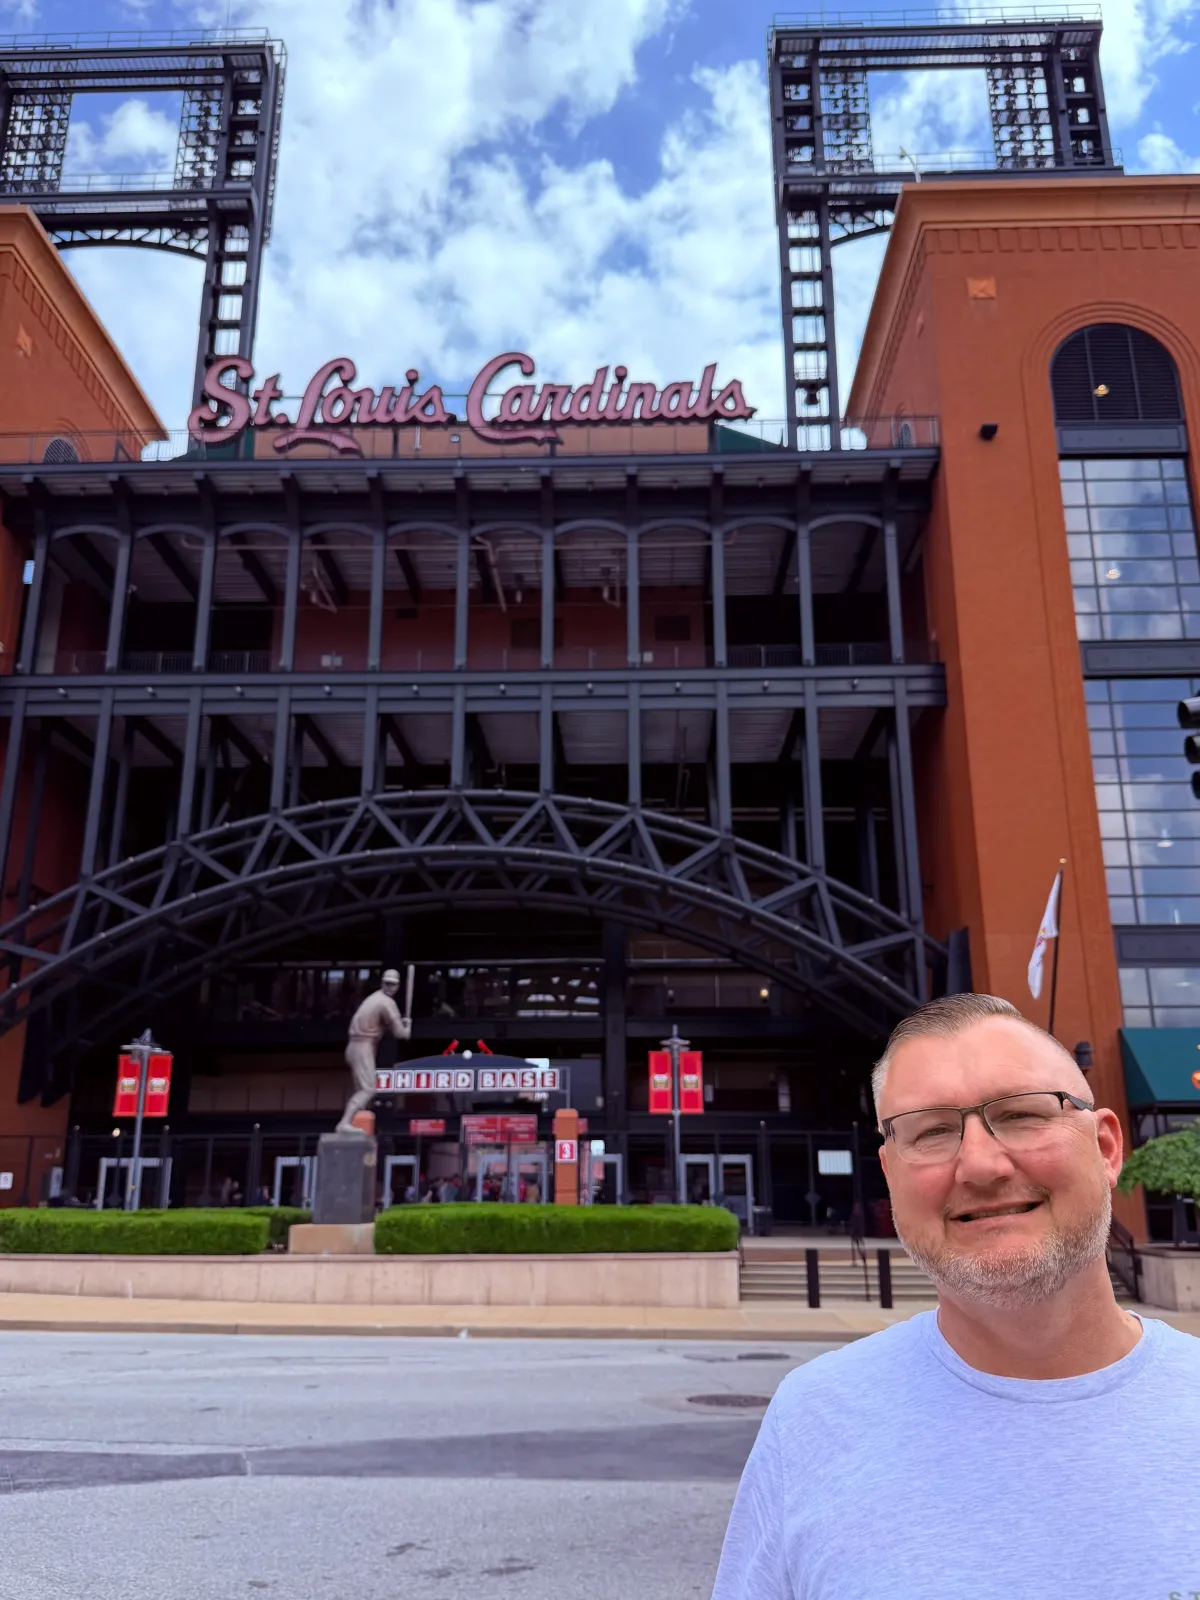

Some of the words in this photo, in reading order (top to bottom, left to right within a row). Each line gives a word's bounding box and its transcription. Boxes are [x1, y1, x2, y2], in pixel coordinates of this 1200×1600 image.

[188, 356, 288, 443] St.
[273, 357, 456, 457] Louis
[466, 352, 756, 444] Cardinals
[377, 1071, 472, 1089] THIRD
[482, 1070, 555, 1089] BASE
[562, 1143, 571, 1159] 3
